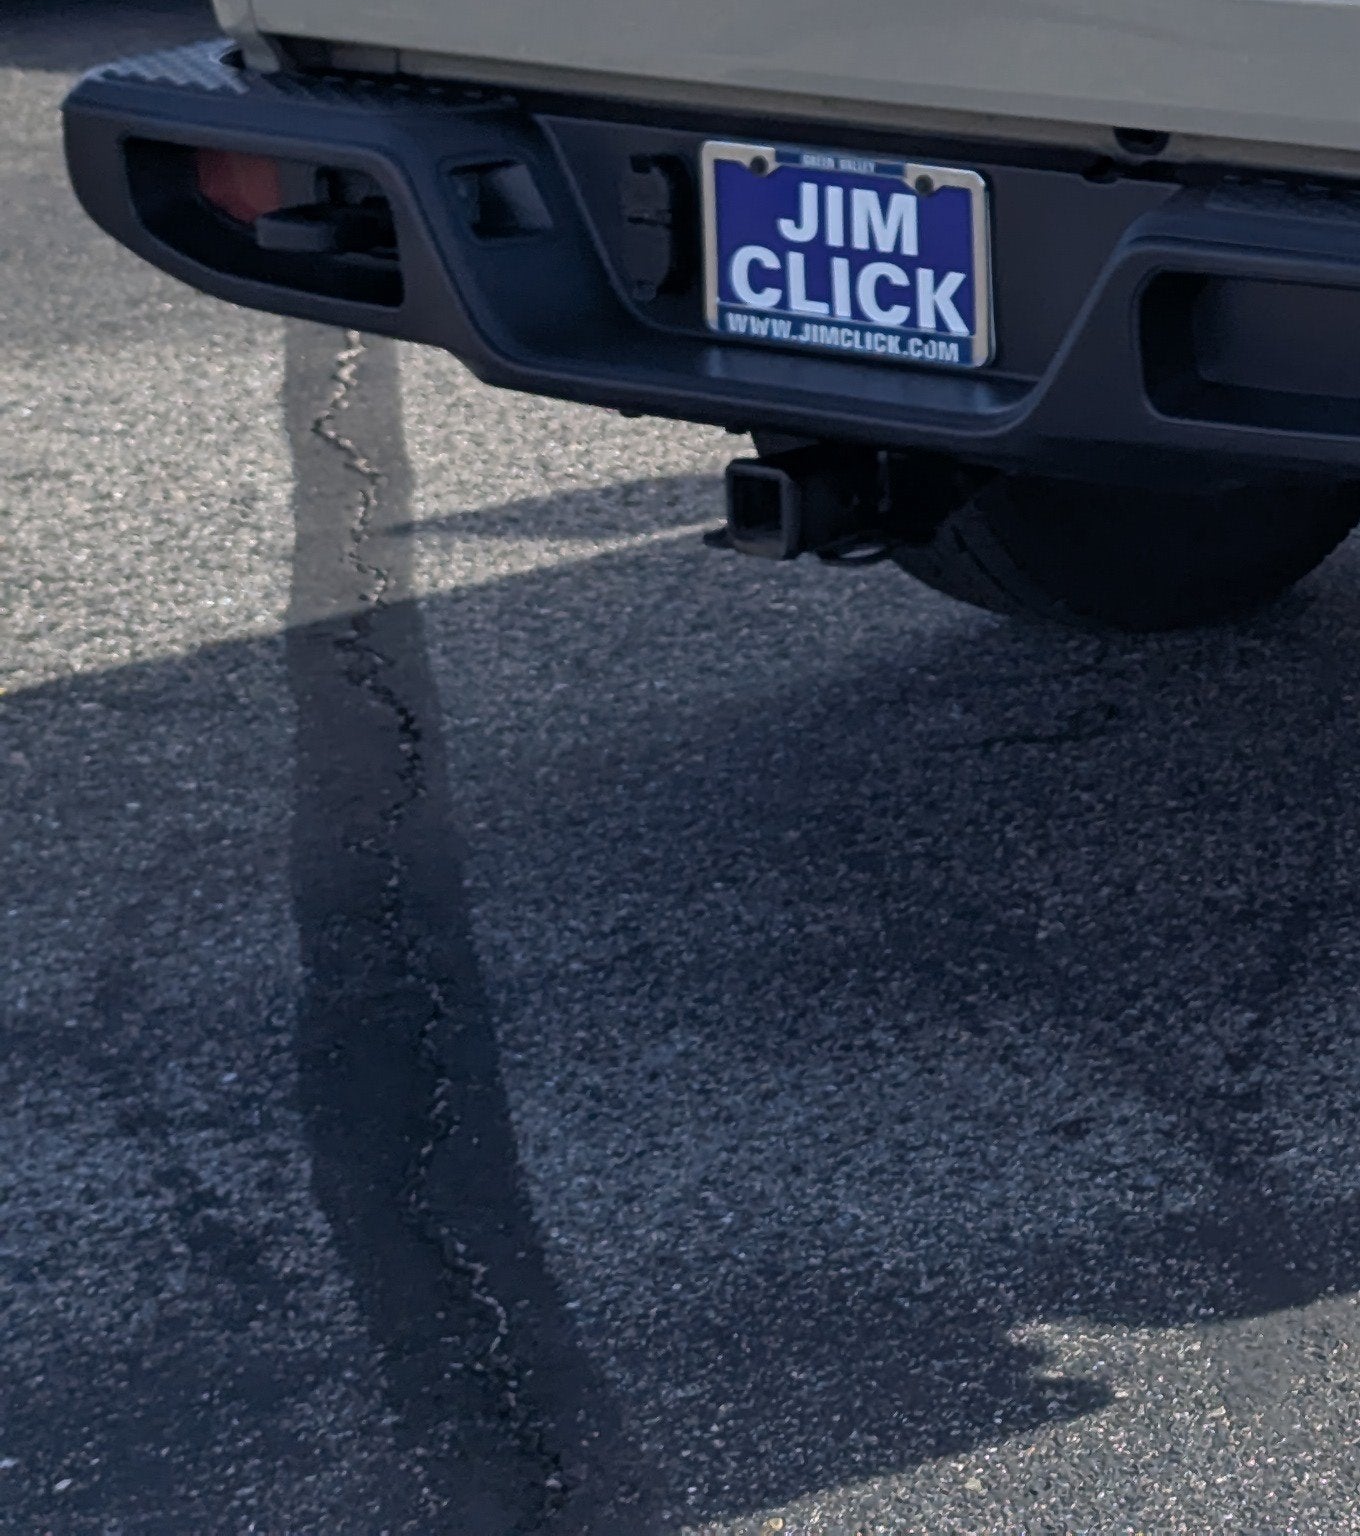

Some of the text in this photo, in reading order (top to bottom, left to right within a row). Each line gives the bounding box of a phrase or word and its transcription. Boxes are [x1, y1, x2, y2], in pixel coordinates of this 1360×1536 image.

[777, 181, 919, 257] JIM
[730, 244, 971, 337] CLICK
[725, 312, 960, 363] WWW.JIMCLICK.COM
